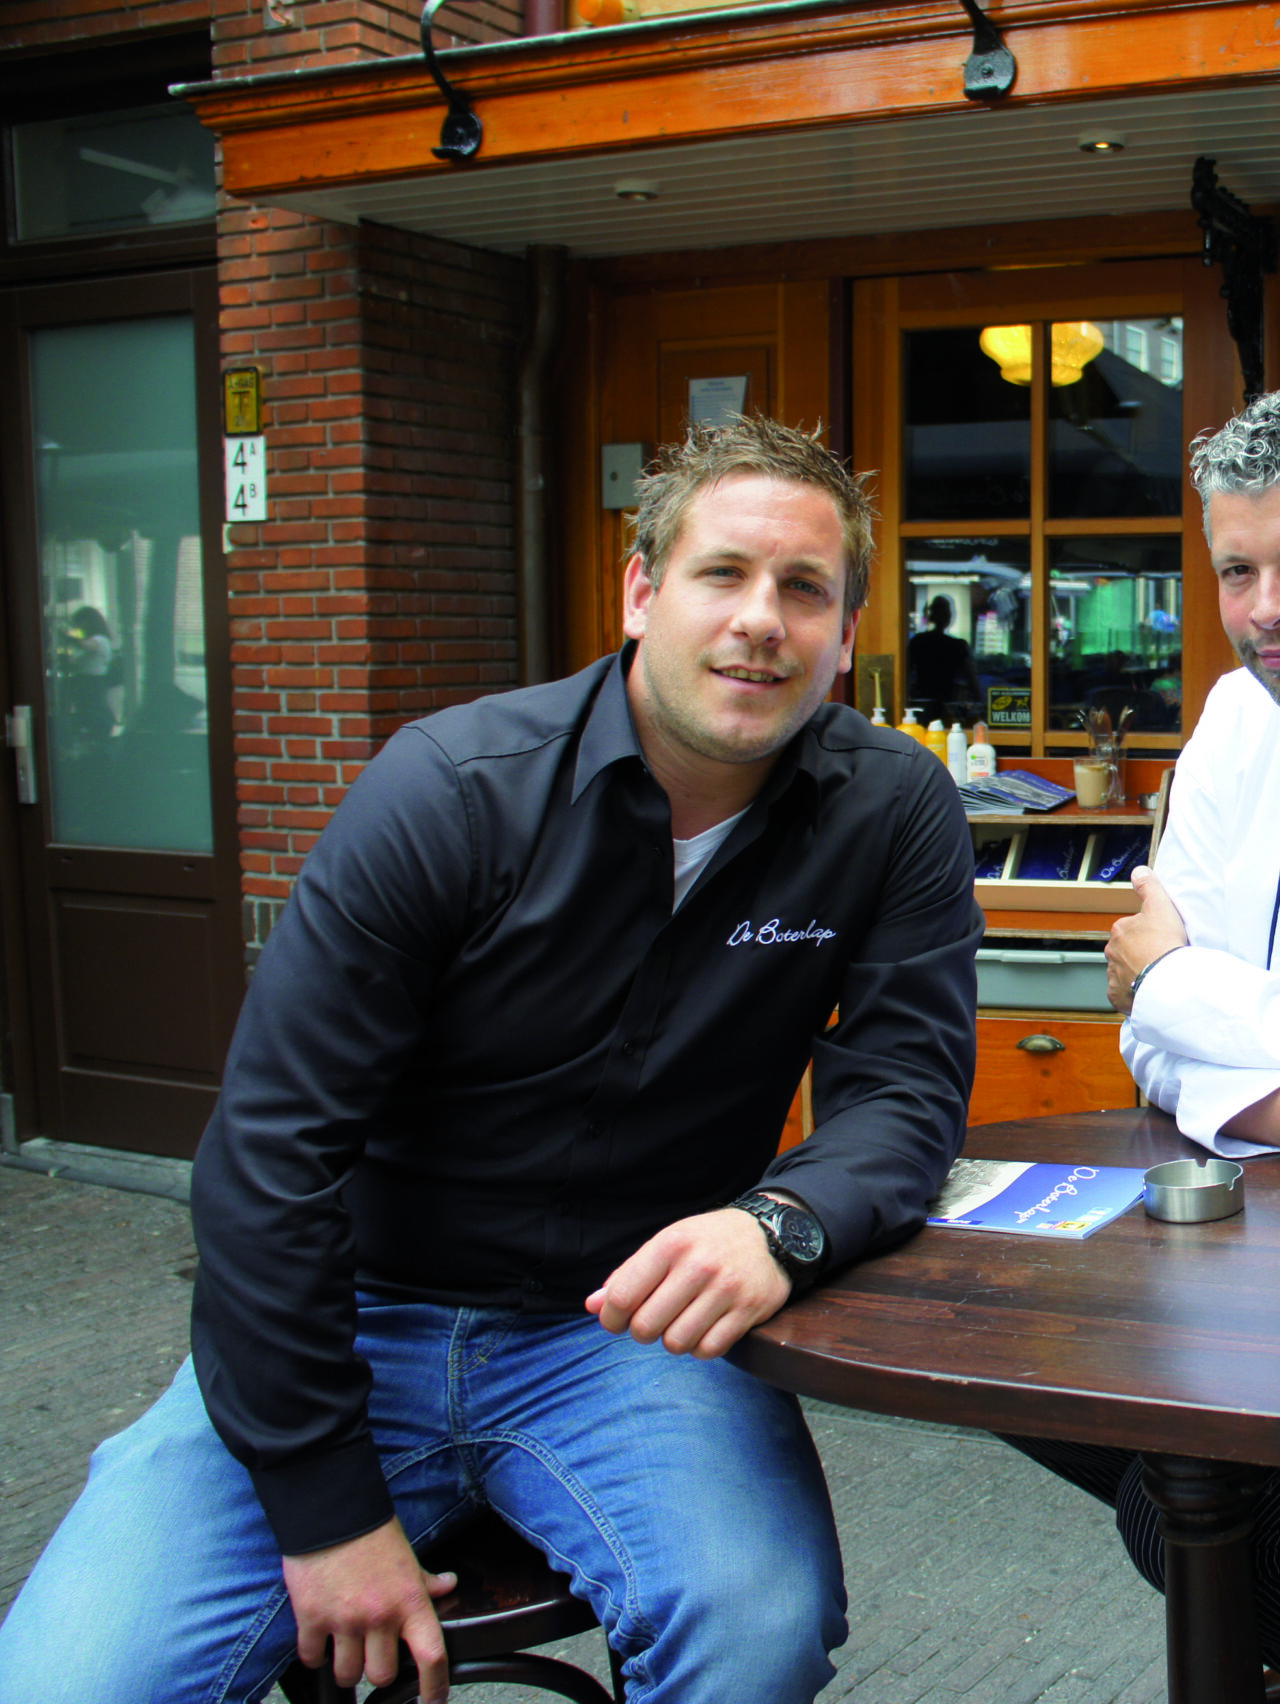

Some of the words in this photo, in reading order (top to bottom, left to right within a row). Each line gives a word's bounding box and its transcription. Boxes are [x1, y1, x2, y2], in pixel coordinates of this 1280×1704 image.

[991, 711, 1031, 723] WELKOM
[725, 920, 755, 947] De
[755, 918, 837, 948] Boterlap
[1067, 1166, 1100, 1183] De
[1013, 1182, 1078, 1224] Boterlap
